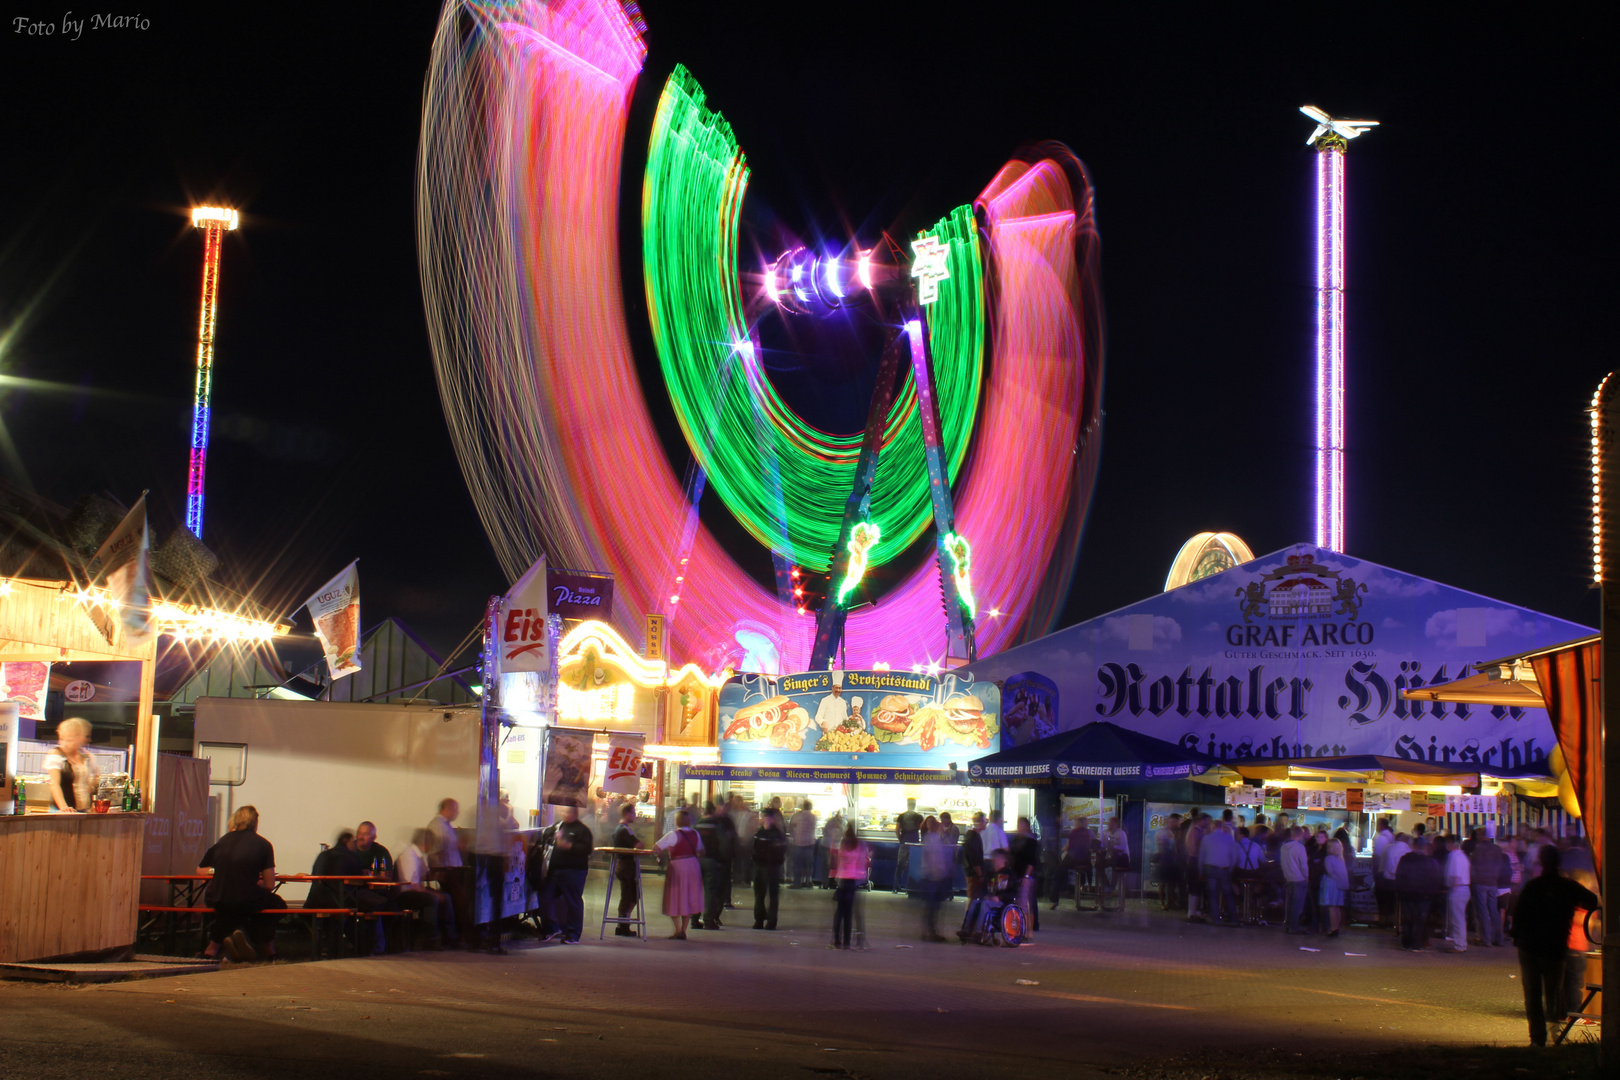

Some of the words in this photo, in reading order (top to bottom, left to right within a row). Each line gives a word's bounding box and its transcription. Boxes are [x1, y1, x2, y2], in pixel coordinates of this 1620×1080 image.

[317, 589, 342, 604] UGUZ
[553, 585, 602, 607] Pizza
[503, 607, 545, 643] Eis
[1226, 623, 1296, 647] GRAF
[1301, 621, 1375, 646] ARCO
[1224, 649, 1257, 659] GUTER
[1324, 648, 1346, 659] SEIT
[848, 672, 932, 691] Brotzeitstandl
[1095, 662, 1314, 721] Rottaler
[608, 746, 640, 772] Eis
[685, 767, 725, 777] Currywurst
[730, 768, 753, 778] Steaks
[757, 768, 781, 778] Bosna
[785, 770, 851, 780] Riesen-Bratwurst
[855, 771, 888, 781] Pommes
[984, 765, 1024, 776] SCHNEIDER
[1024, 763, 1050, 775] WEISSE
[1071, 765, 1112, 776] SCHNEIDER
[1113, 765, 1141, 776] WEISSE
